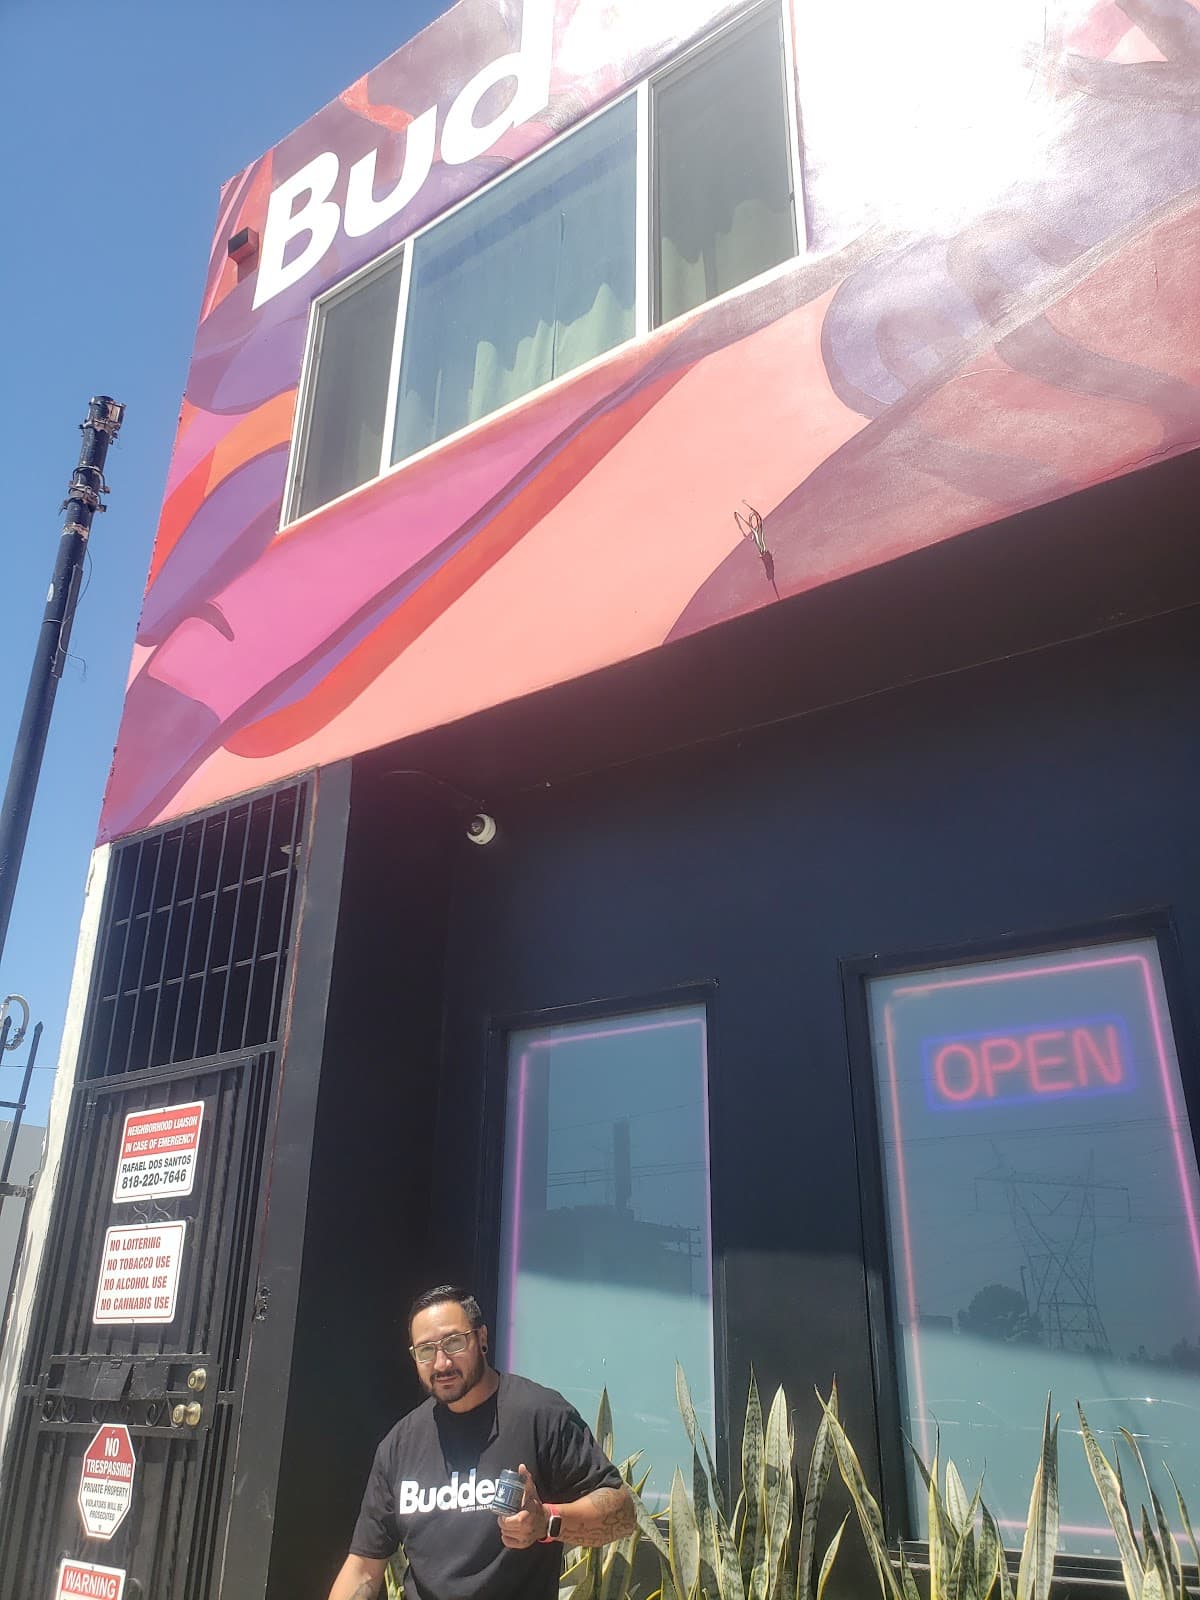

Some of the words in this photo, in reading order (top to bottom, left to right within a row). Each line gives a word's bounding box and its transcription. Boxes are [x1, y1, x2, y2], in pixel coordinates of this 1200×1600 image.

[934, 1026, 1123, 1101] OPEN
[127, 1120, 173, 1136] NEIGHBORHOOD
[174, 1116, 198, 1129] LIAISON
[125, 1143, 132, 1152] IN
[133, 1141, 149, 1151] CASE
[149, 1138, 158, 1149] OF
[158, 1133, 195, 1148] EMERGENCY
[122, 1161, 147, 1173] RAFAEL
[148, 1158, 163, 1170] DOS
[163, 1154, 192, 1168] SANTOS
[121, 1169, 187, 1189] 818-220-7646
[109, 1239, 121, 1252] NO
[122, 1236, 162, 1251] LOITERING
[106, 1258, 118, 1271] NO
[119, 1256, 154, 1270] TOBACCO
[155, 1255, 171, 1268] USE
[103, 1278, 115, 1291] NO
[115, 1276, 150, 1290] ALCOHOL
[151, 1275, 168, 1289] USE
[100, 1298, 112, 1311] NO
[113, 1296, 152, 1310] CANNABIS
[153, 1296, 170, 1310] USE
[104, 1437, 120, 1457] NO
[86, 1458, 132, 1478] TRESPASSING
[83, 1482, 104, 1494] PRIVATE
[103, 1485, 129, 1498] PROPERTY
[85, 1498, 106, 1509] VIOLATORS
[117, 1504, 123, 1512] BE
[89, 1510, 116, 1521] PROSECUTED
[65, 1570, 117, 1599] WARNING
